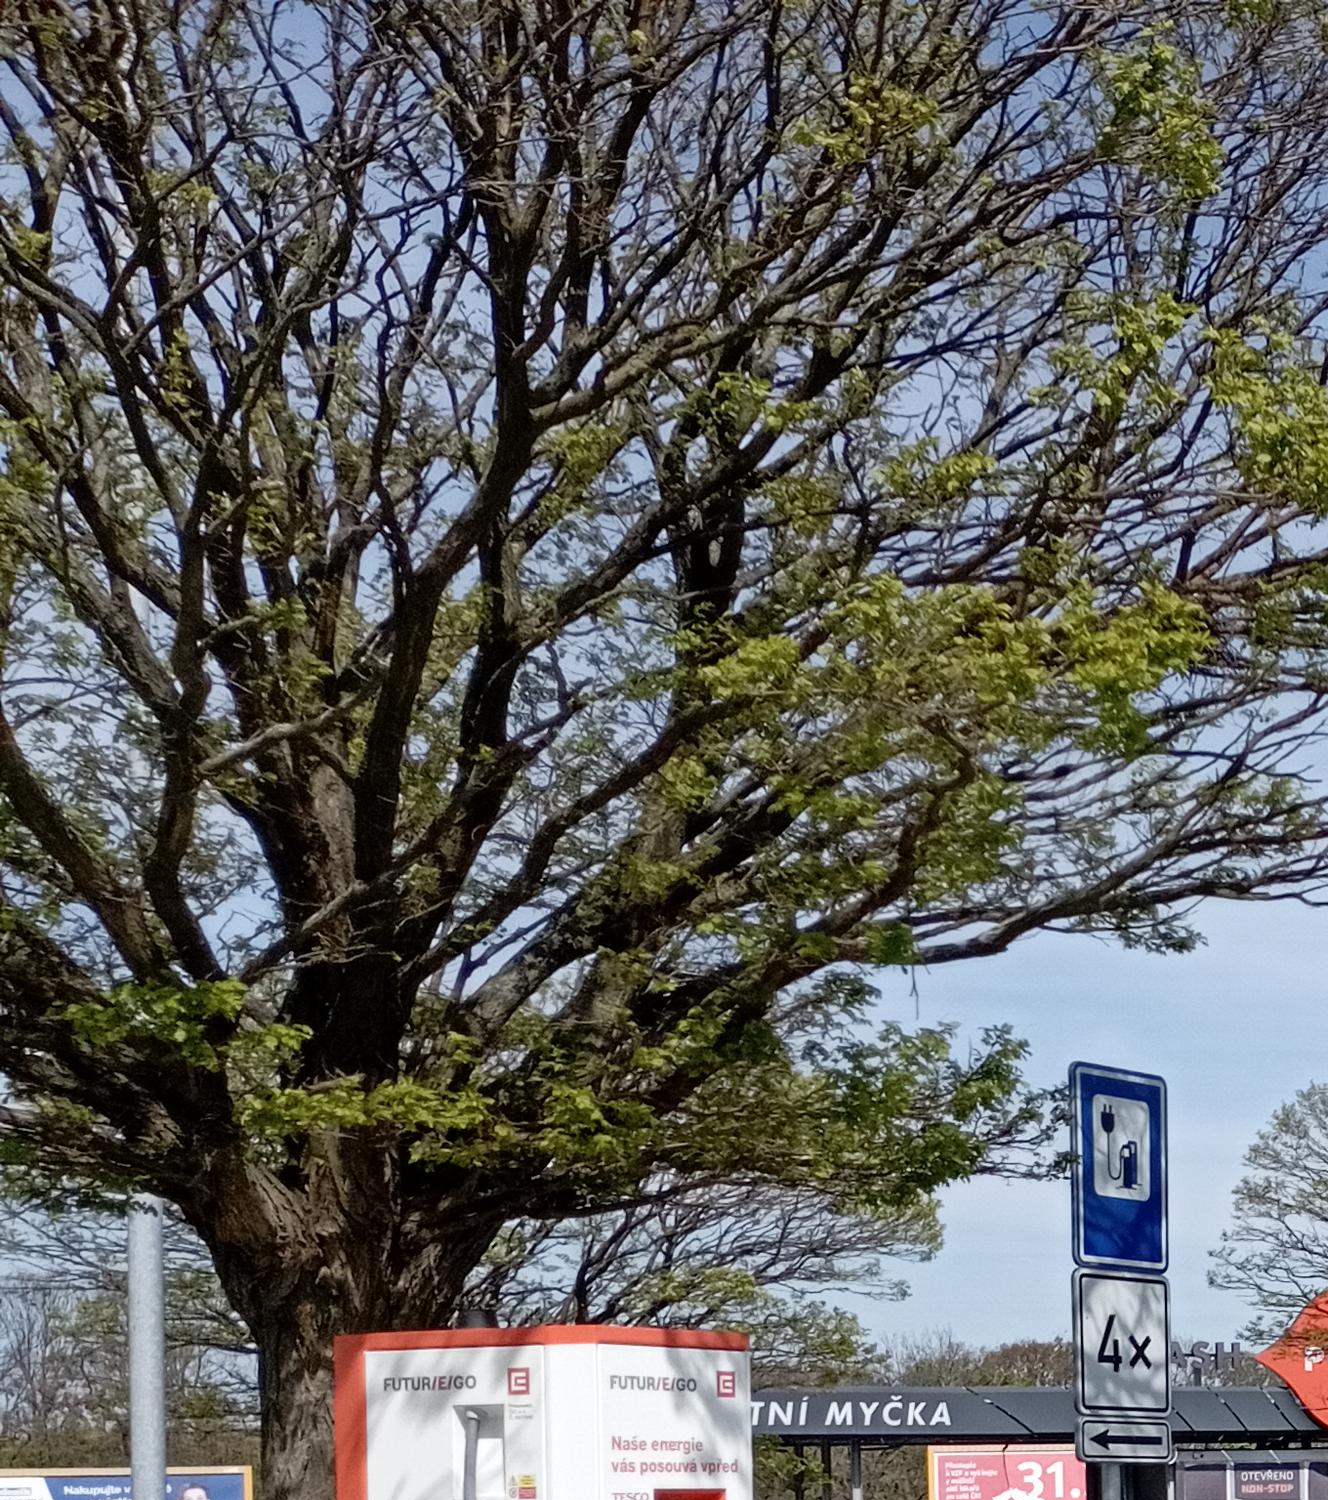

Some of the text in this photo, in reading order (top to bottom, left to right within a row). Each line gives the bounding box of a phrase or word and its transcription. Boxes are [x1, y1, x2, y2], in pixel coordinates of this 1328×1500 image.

[1171, 1340, 1240, 1369] ASH
[383, 1375, 477, 1392] FUTUR/E/GO
[610, 1374, 698, 1392] FUTUR/E/GO
[750, 1395, 952, 1426] TNÍ MYČKA
[611, 1436, 704, 1455] Naše energie
[611, 1458, 739, 1476] vás posouvá vpřed
[1241, 1469, 1294, 1482] OTEVŘENO
[1241, 1484, 1294, 1494] NON-STOP
